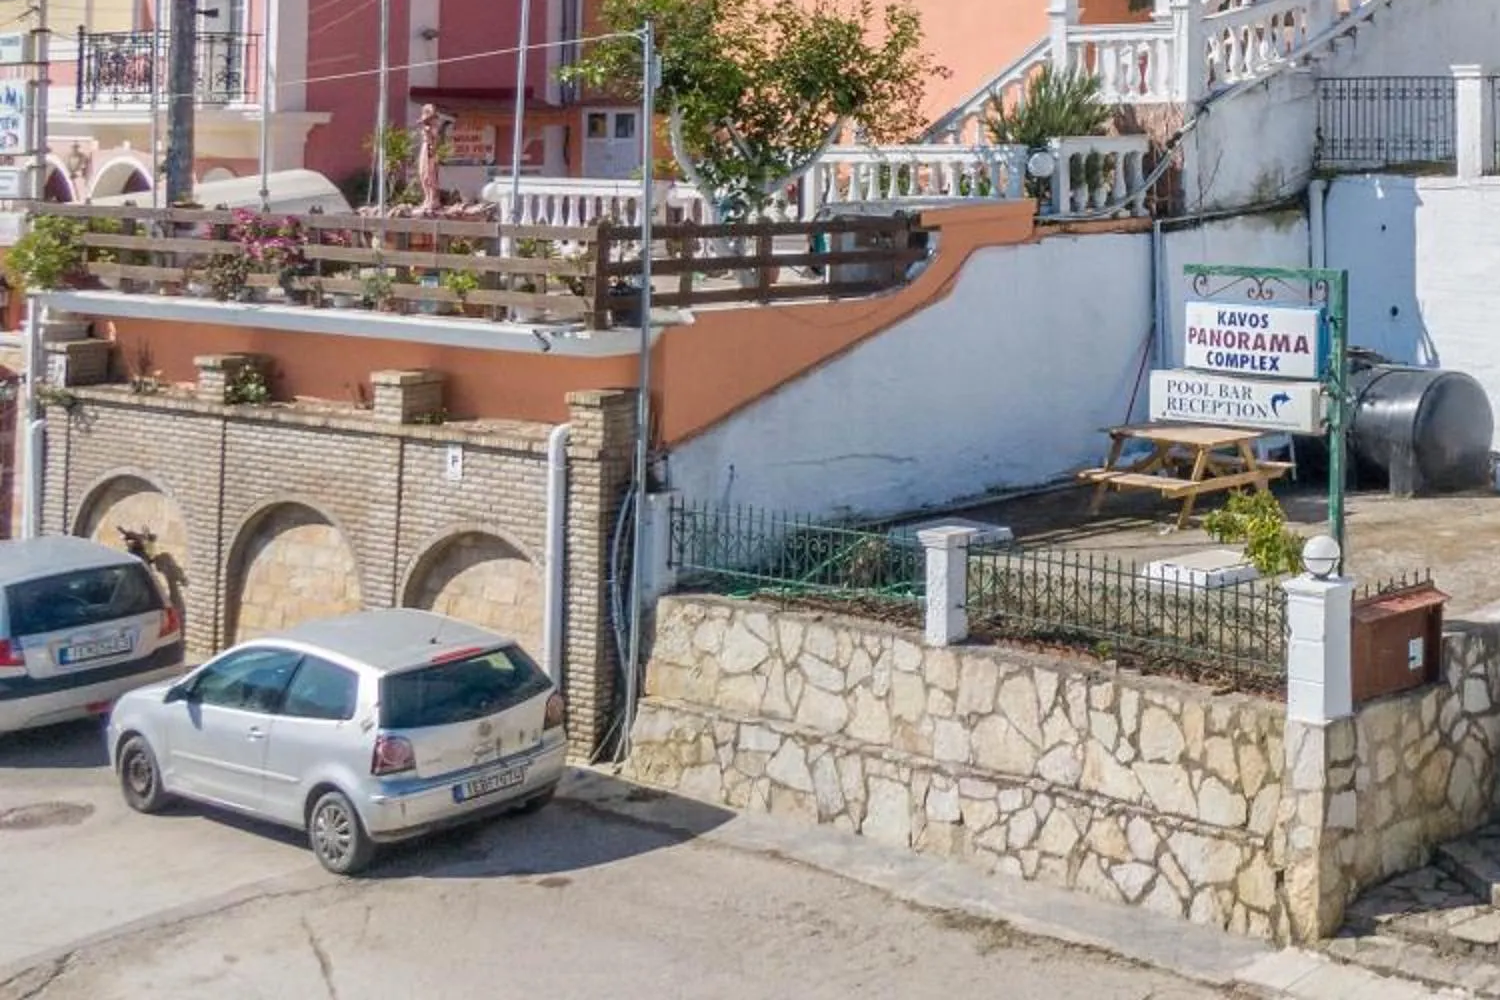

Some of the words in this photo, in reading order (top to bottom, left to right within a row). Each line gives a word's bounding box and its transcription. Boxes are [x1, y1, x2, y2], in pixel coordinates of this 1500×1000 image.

[1217, 310, 1270, 329] KAVOS
[1188, 327, 1310, 354] PANORAMA
[1206, 350, 1280, 371] COMPLEX
[1167, 379, 1214, 398] POOL
[1219, 383, 1253, 400] BAR
[1166, 397, 1269, 418] RECEPTION
